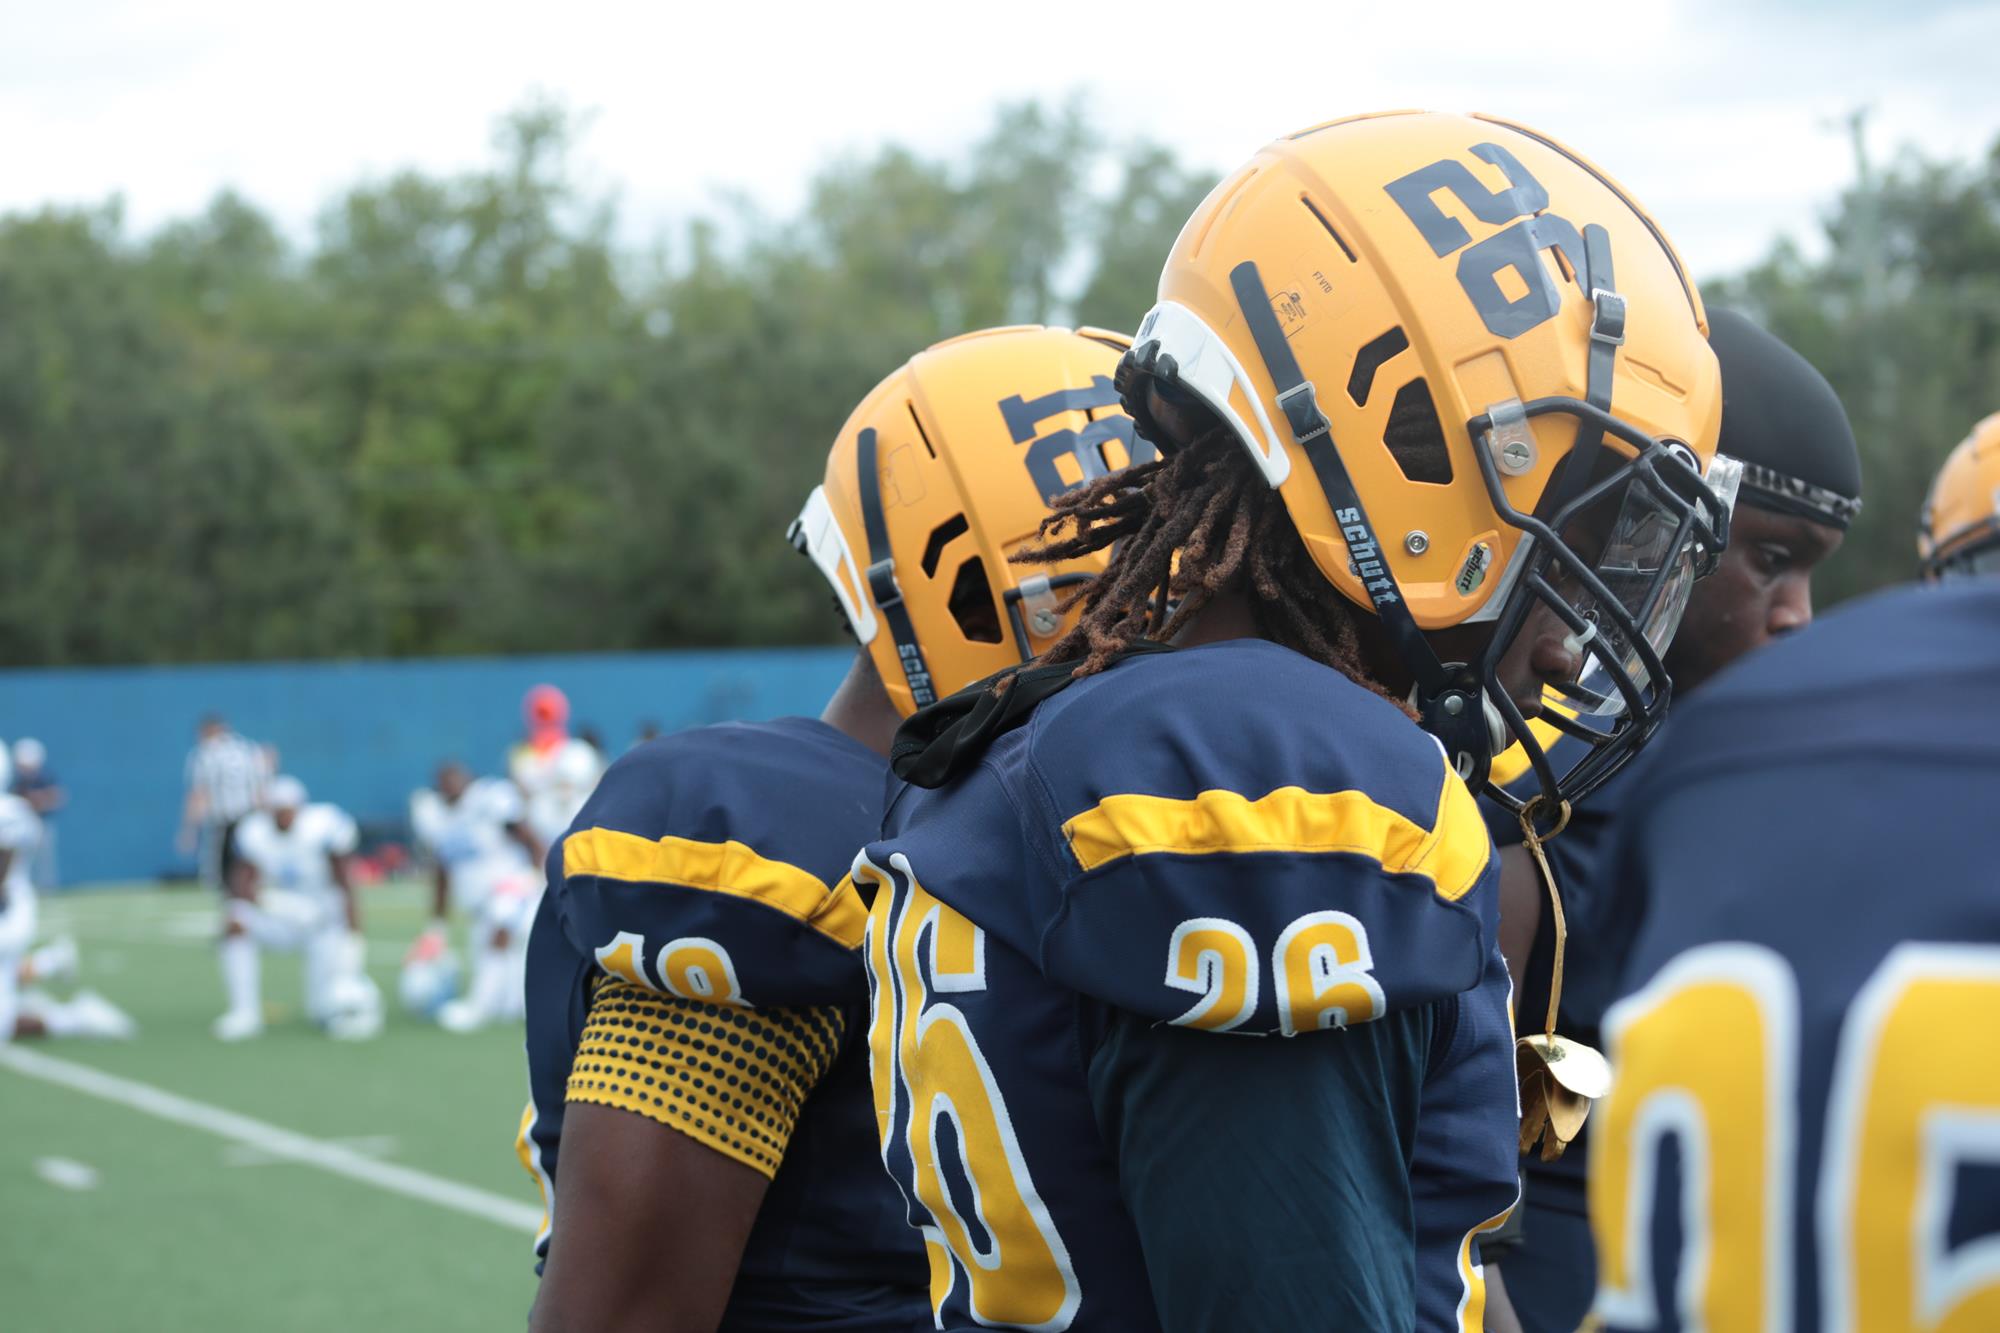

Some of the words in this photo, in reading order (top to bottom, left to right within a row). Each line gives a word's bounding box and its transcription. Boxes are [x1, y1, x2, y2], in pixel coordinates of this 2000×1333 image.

[1383, 142, 1592, 340] 26
[1335, 507, 1399, 606] schutt
[898, 643, 935, 705] schu
[1164, 910, 1387, 1037] 26
